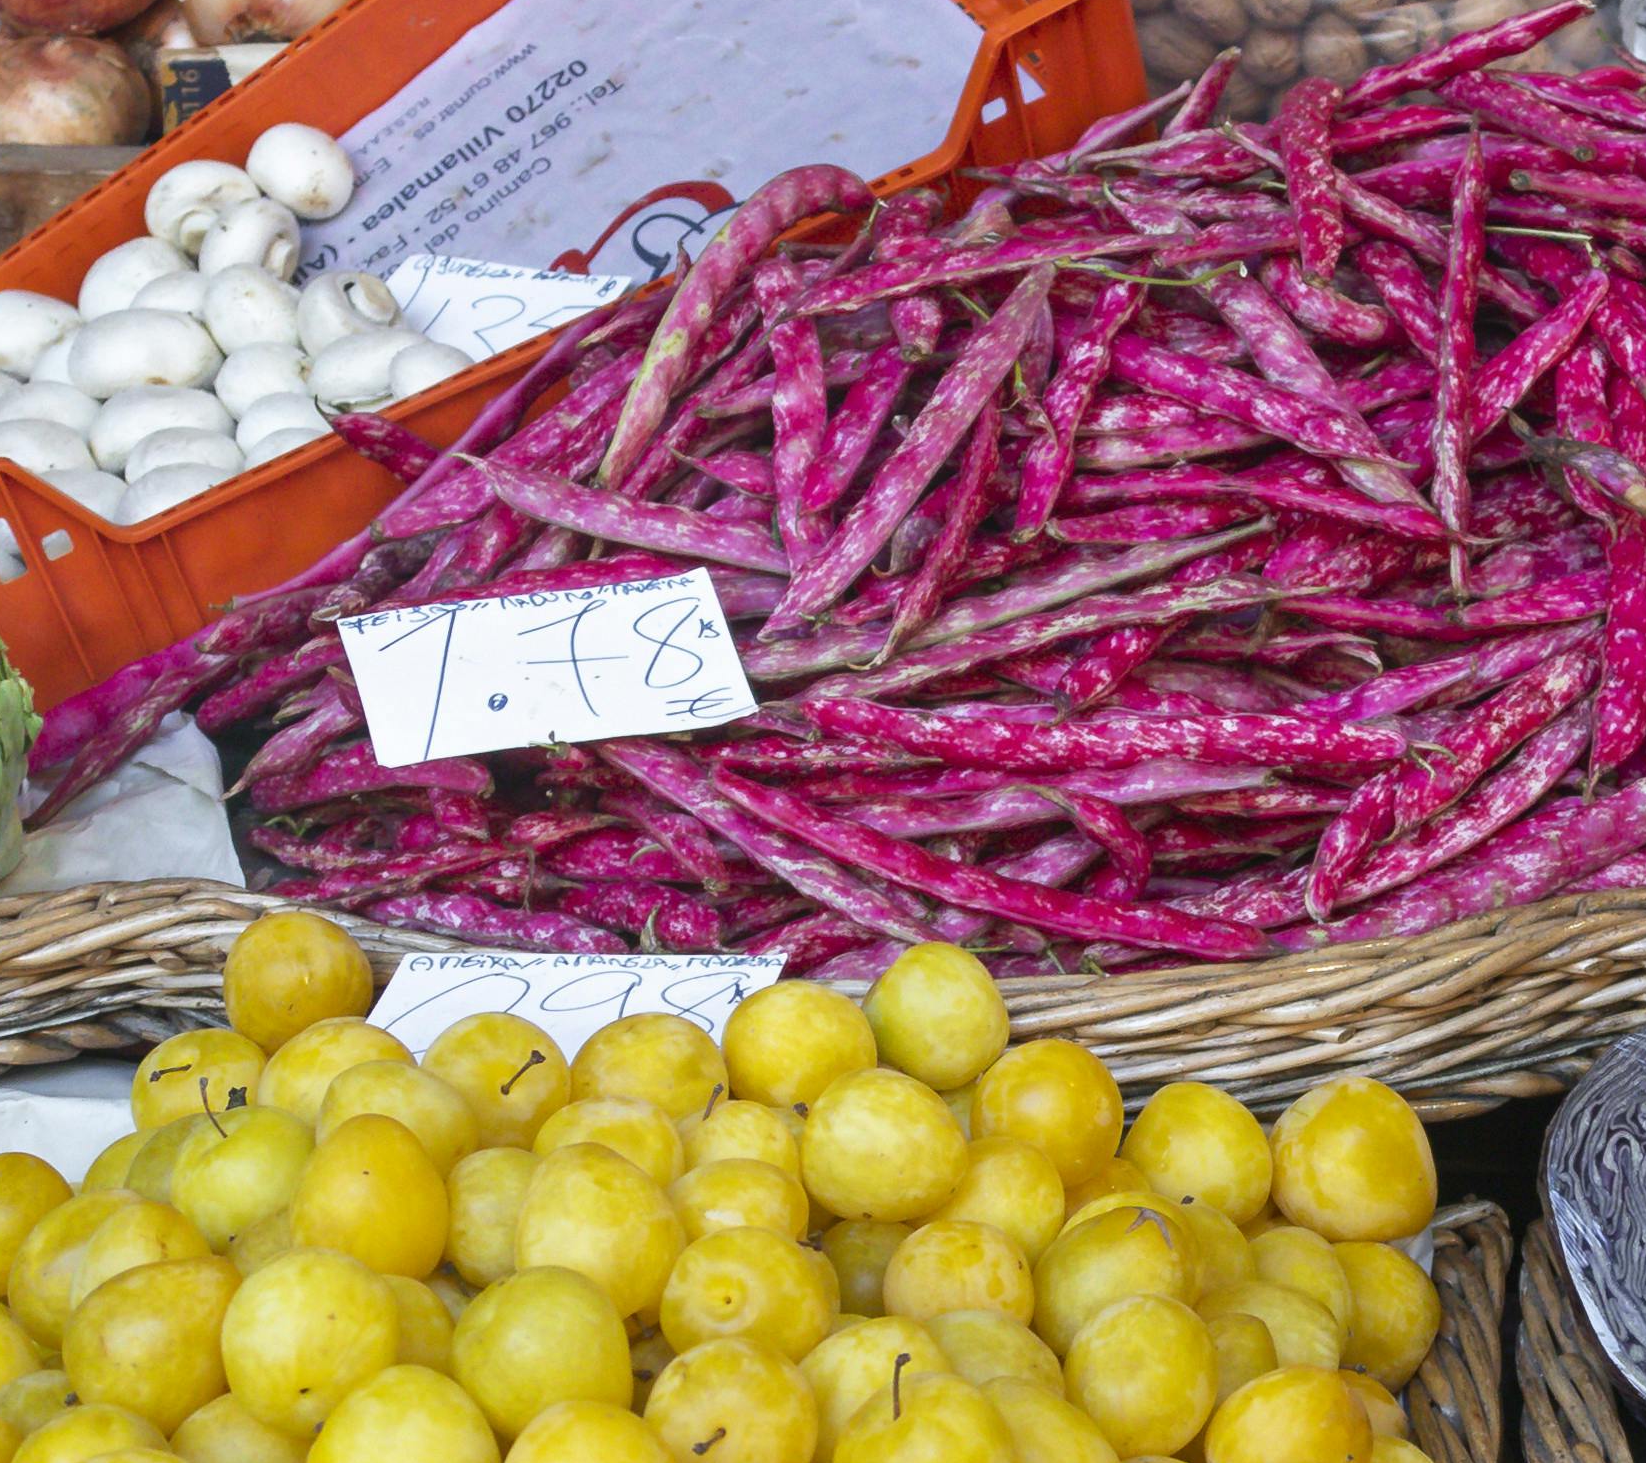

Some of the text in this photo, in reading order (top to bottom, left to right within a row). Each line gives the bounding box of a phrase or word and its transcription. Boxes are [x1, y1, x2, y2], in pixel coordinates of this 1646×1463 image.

[412, 42, 538, 141] www.cumar.es
[505, 57, 589, 125] 02270
[529, 114, 573, 153] 967
[361, 124, 505, 233] Villamalea
[458, 173, 490, 202] 61
[491, 149, 523, 174] 48
[423, 155, 553, 256] Camino del
[424, 201, 457, 228] 52
